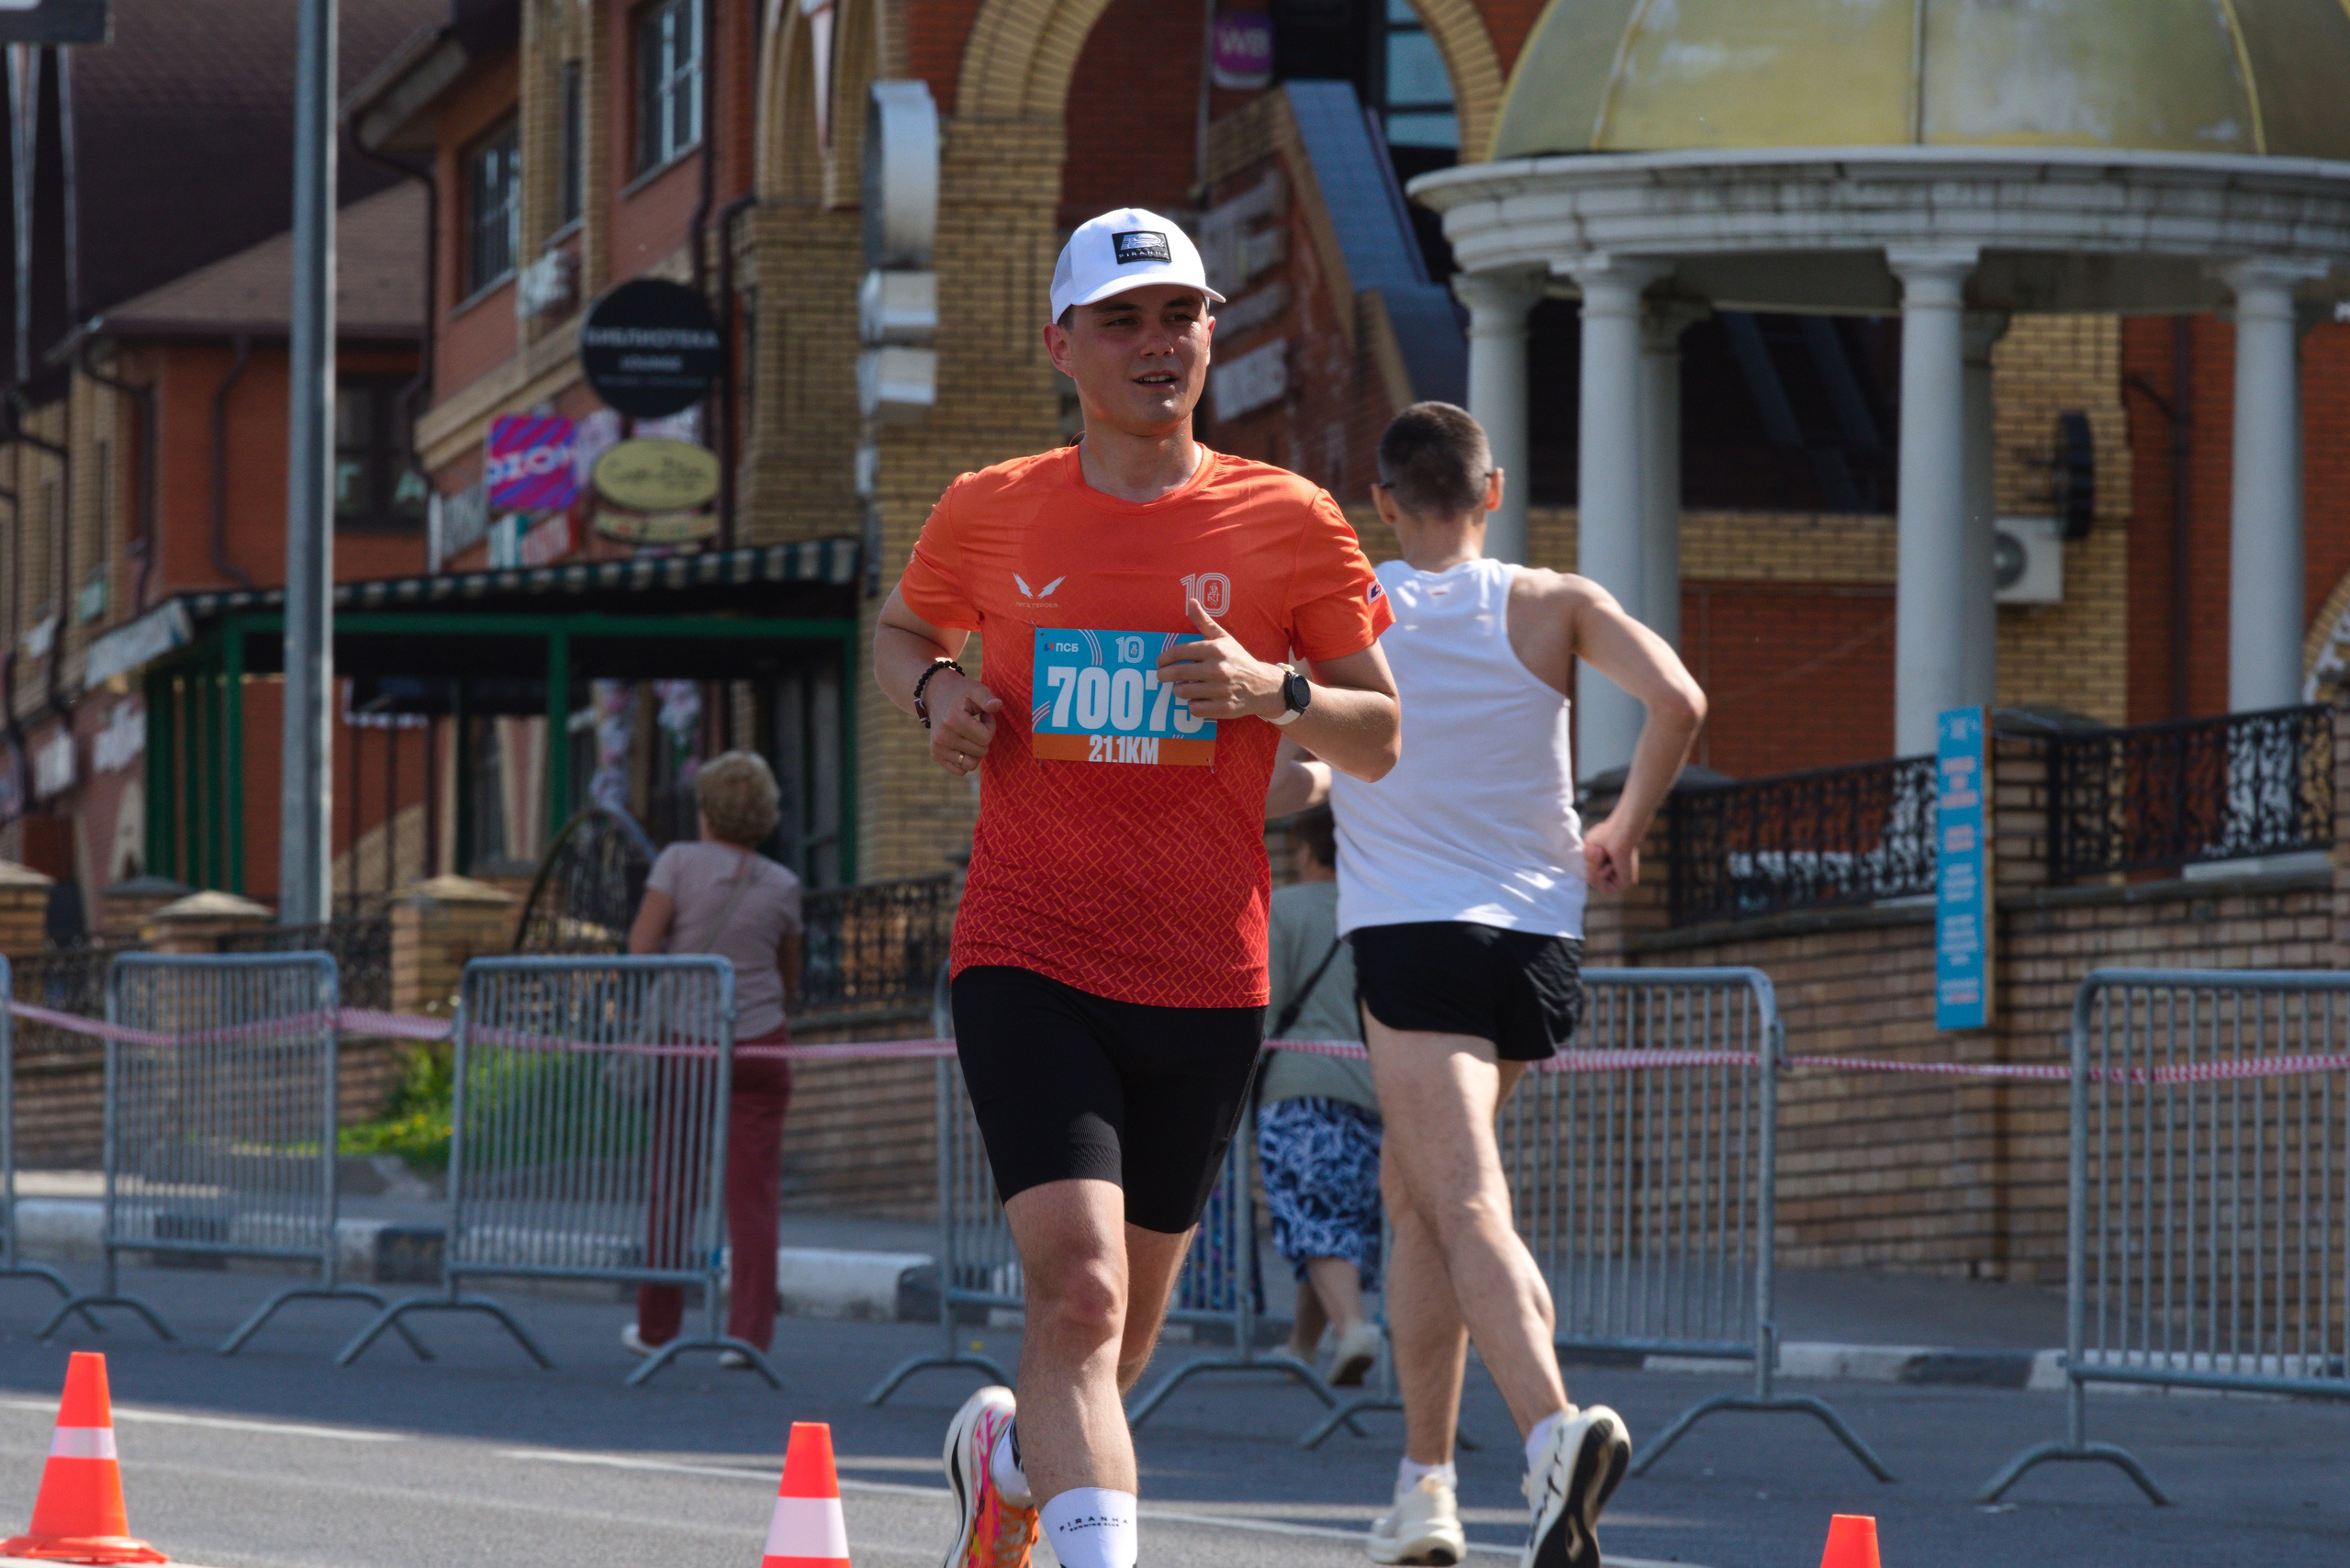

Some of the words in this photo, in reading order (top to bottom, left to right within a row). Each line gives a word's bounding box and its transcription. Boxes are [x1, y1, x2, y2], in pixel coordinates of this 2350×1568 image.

[1055, 642, 1079, 653] ПСБ
[1115, 635, 1145, 663] 10
[1059, 1516, 1128, 1532] PIRANHA
